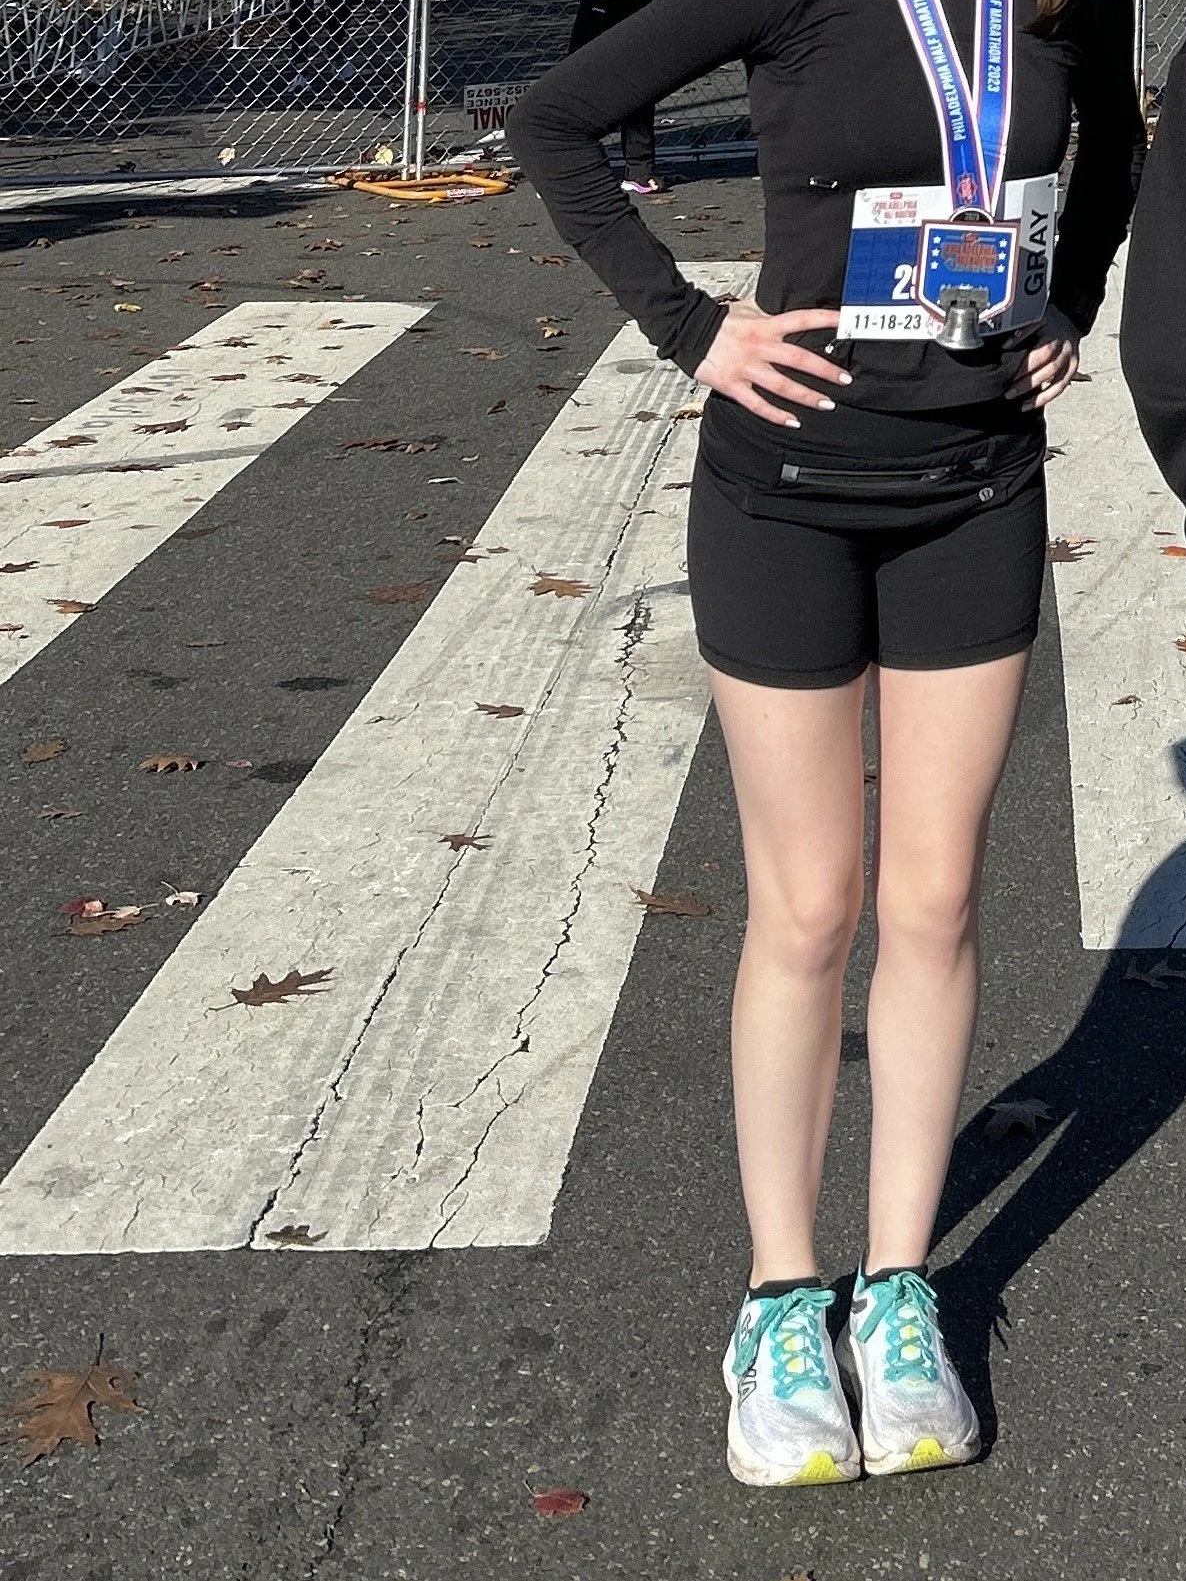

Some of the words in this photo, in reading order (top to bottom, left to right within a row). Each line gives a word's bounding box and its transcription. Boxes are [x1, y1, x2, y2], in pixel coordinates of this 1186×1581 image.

[926, 32, 948, 64] HALF
[988, 8, 1003, 64] MARATHON
[987, 65, 1001, 93] 2023
[936, 60, 967, 142] PHILADELPHIA
[1023, 209, 1049, 296] GRAY
[892, 264, 917, 300] 2
[854, 314, 922, 330] 11-18-23
